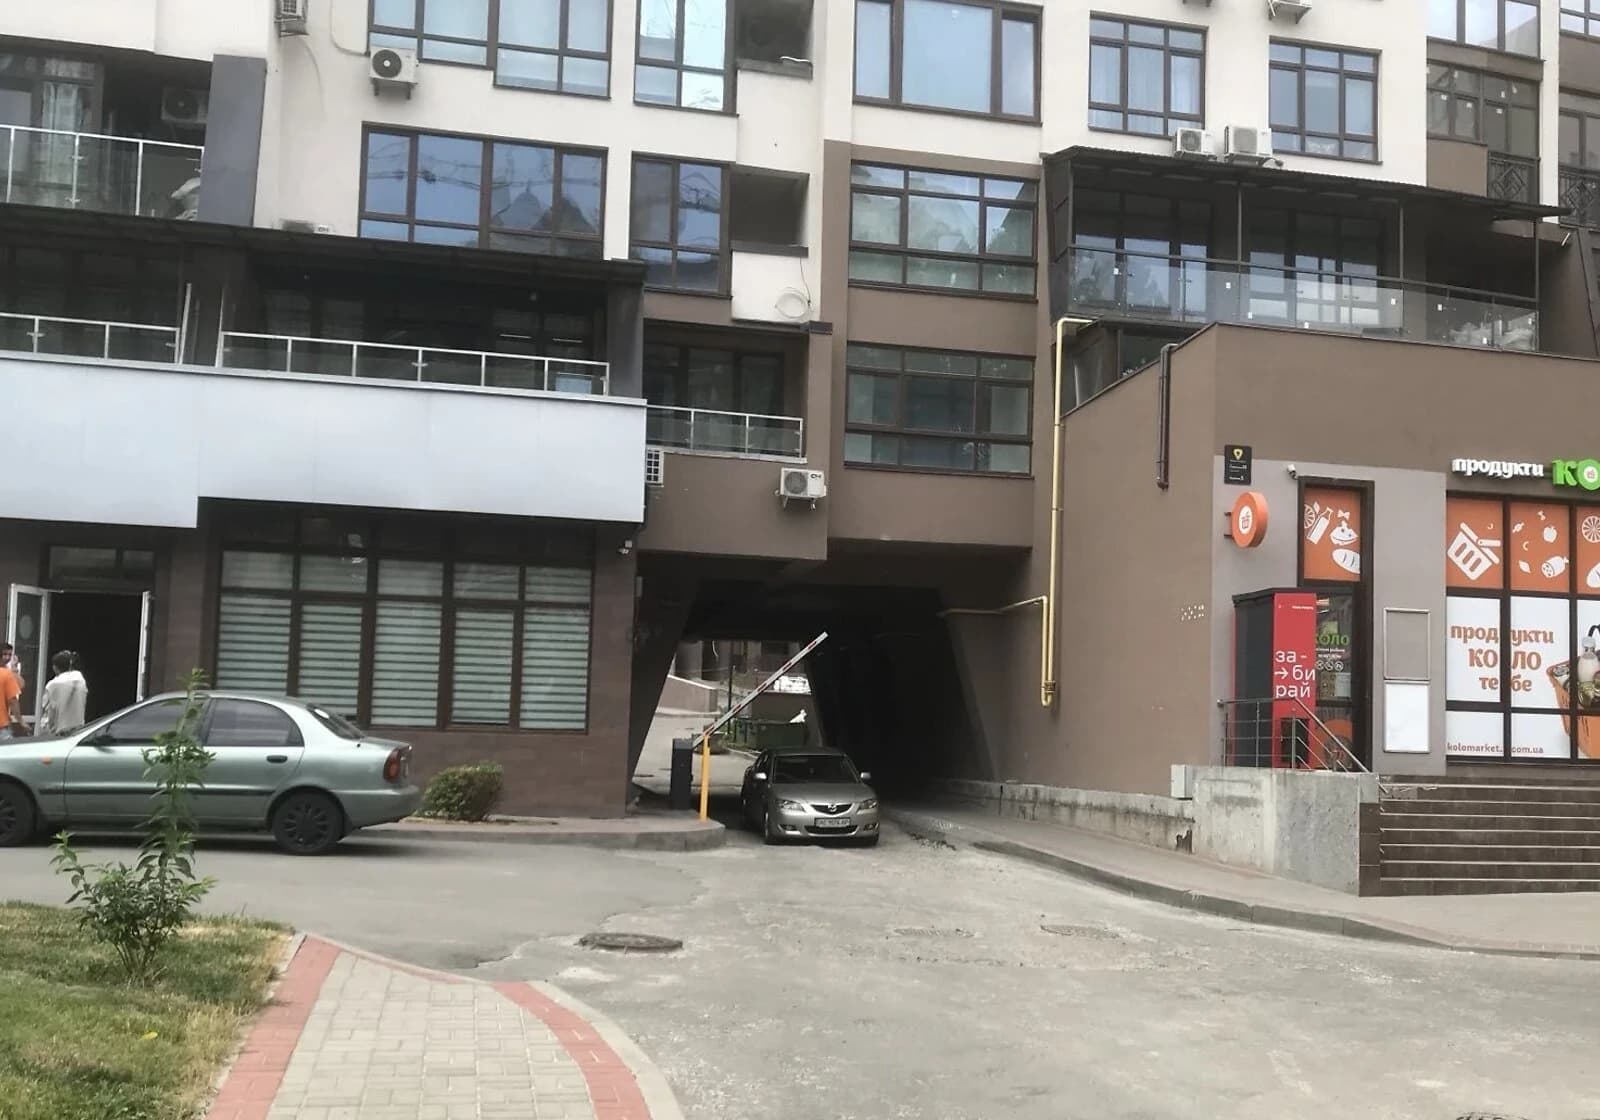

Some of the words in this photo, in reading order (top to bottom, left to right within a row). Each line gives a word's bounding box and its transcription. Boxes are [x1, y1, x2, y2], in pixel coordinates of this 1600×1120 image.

[1452, 458, 1544, 478] продукти
[1451, 625, 1554, 646] продукти
[1292, 664, 1316, 681] би
[1275, 681, 1311, 698] рай
[1479, 674, 1532, 692] тебе
